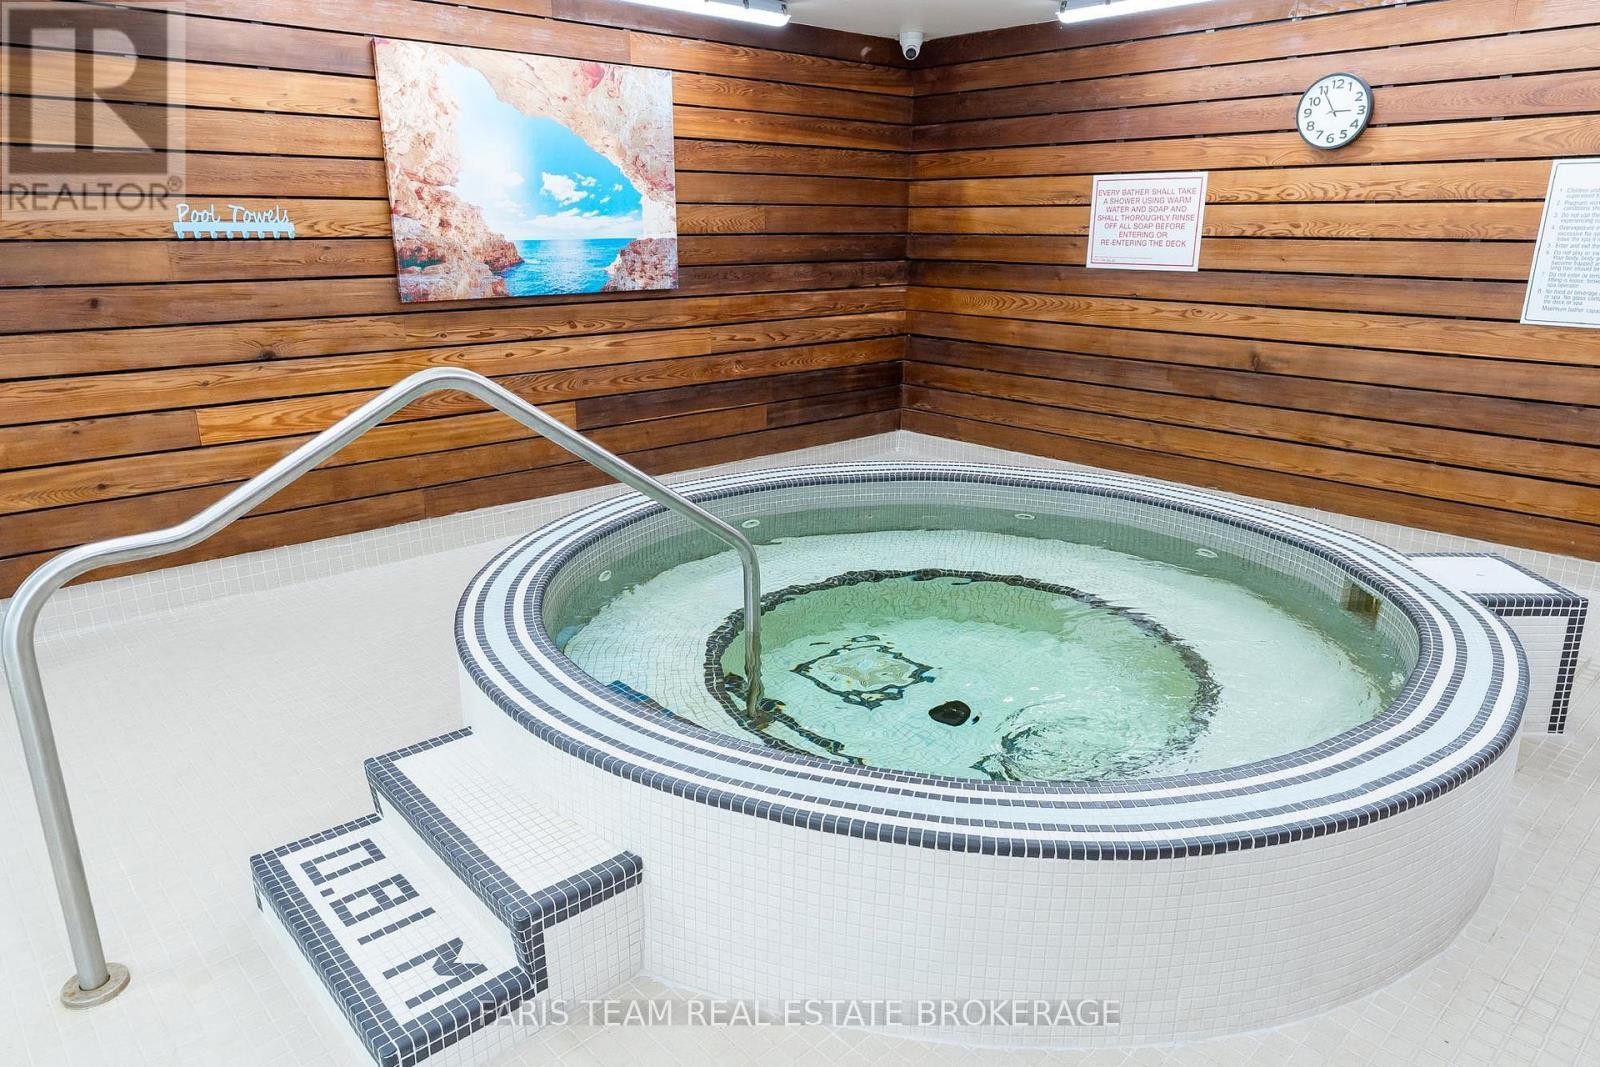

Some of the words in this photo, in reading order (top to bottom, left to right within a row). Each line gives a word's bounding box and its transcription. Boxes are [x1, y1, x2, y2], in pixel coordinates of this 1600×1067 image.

[1332, 78, 1344, 88] 12
[1348, 82, 1352, 92] 1
[1320, 86, 1328, 94] 11
[1355, 92, 1363, 101] 2
[1310, 97, 1320, 106] 10
[1304, 108, 1312, 118] 9
[1357, 106, 1366, 114] 3
[1306, 121, 1314, 131] 8
[1350, 119, 1358, 128] 4
[1316, 130, 1323, 139] 7
[1326, 133, 1334, 143] 6
[1340, 130, 1347, 138] 5
[176, 203, 220, 223] Pool
[227, 204, 289, 223] Towels
